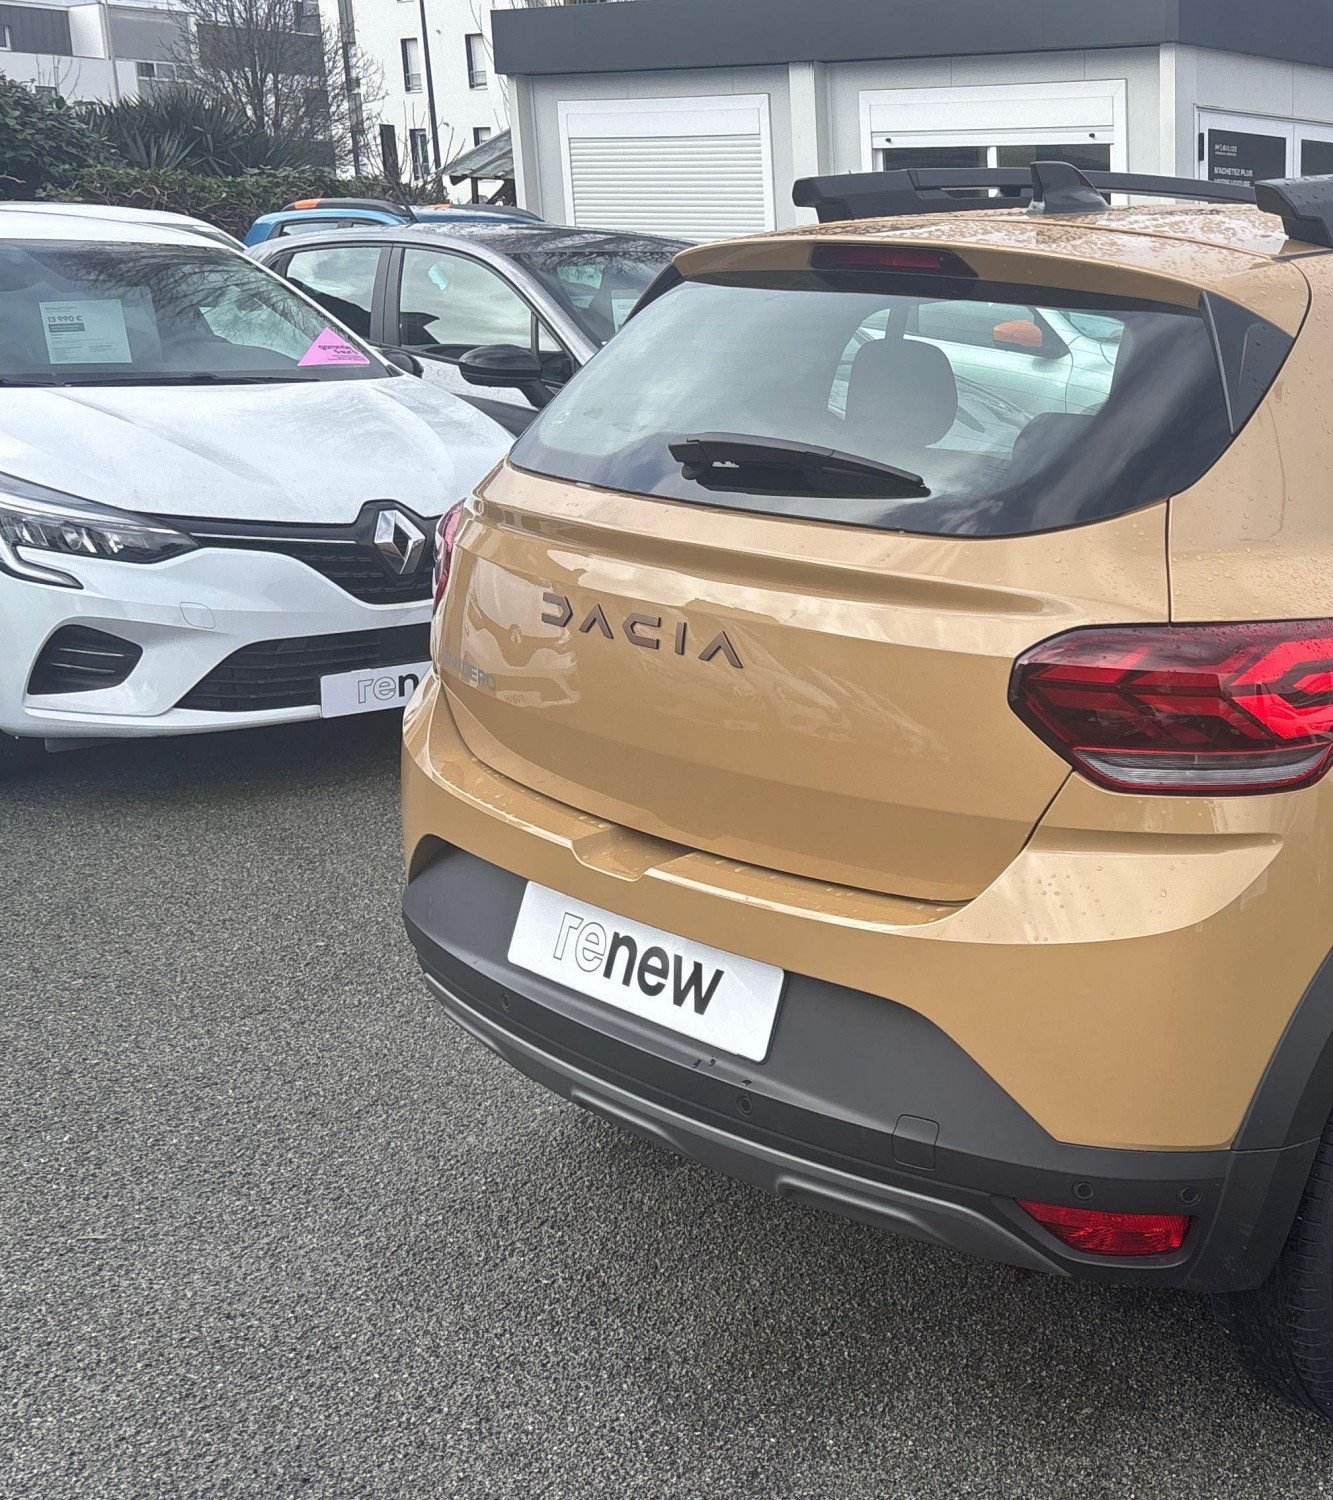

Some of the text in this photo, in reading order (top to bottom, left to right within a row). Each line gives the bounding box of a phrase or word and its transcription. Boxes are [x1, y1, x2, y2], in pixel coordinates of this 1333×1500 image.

[1241, 169, 1253, 177] PLUS
[541, 592, 744, 669] DACIA
[357, 673, 419, 704] ren
[553, 911, 725, 1016] renew
